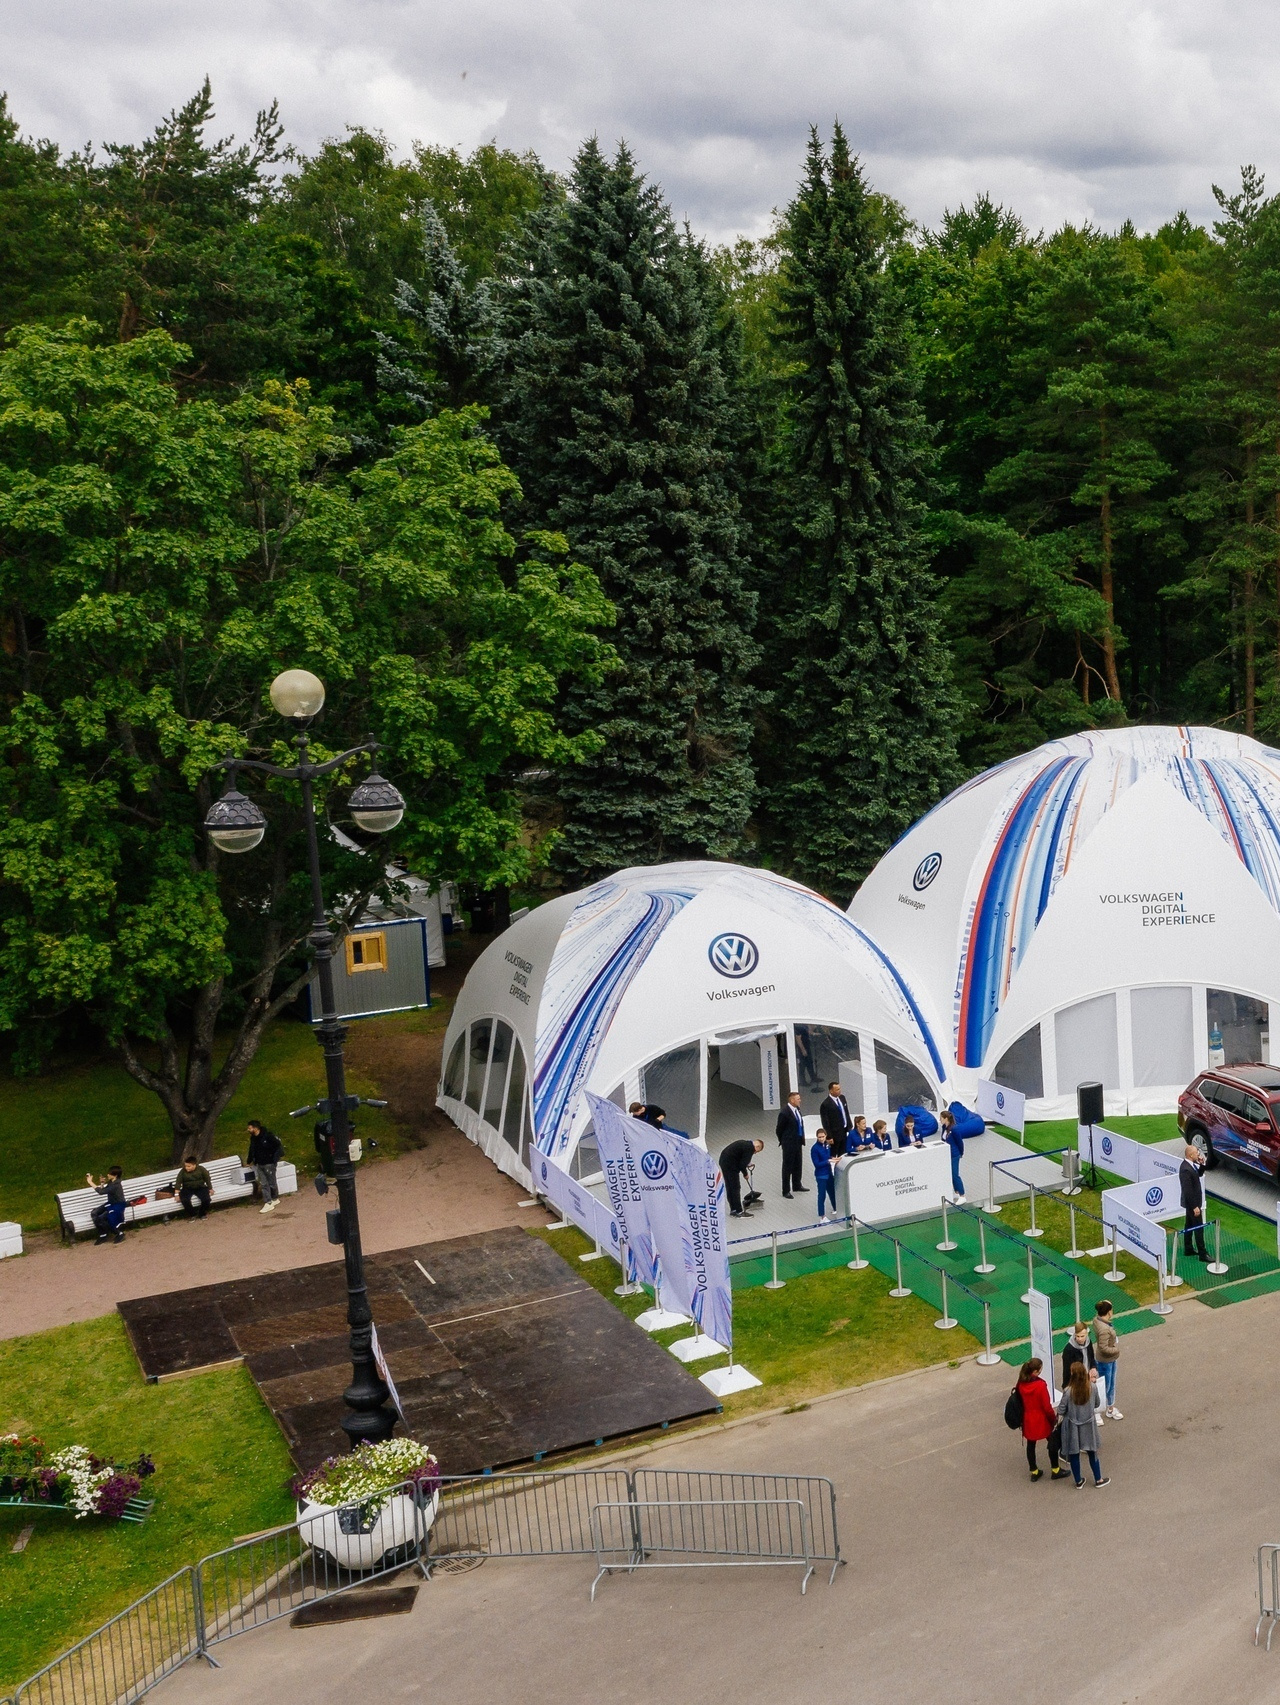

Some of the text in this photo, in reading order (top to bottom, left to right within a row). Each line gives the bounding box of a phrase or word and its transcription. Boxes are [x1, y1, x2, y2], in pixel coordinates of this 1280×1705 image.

[898, 893, 926, 910] Volkswagen
[1099, 892, 1183, 904] VOLKSWAGEN
[1142, 904, 1187, 914] DIGITAL
[1142, 914, 1216, 927] EXPERIENCE
[504, 950, 533, 975] VOLKSWAGEN
[513, 971, 528, 988] DIGITAL
[509, 984, 531, 1006] EXPERIENCE
[706, 983, 776, 1001] Volkswagen
[1248, 1138, 1271, 1153] VOLKSWAGEN
[617, 1156, 630, 1202] DIGITAL
[876, 1176, 914, 1188] VOLKSWAGEN
[894, 1182, 915, 1190] DIGITAL
[895, 1184, 928, 1196] EXPERIENCE
[605, 1159, 629, 1244] VOLKSWAGEN
[705, 1172, 721, 1252] EXPERIENCE
[699, 1201, 711, 1250] DIGITAL
[688, 1204, 708, 1293] VOLKSWAGEN
